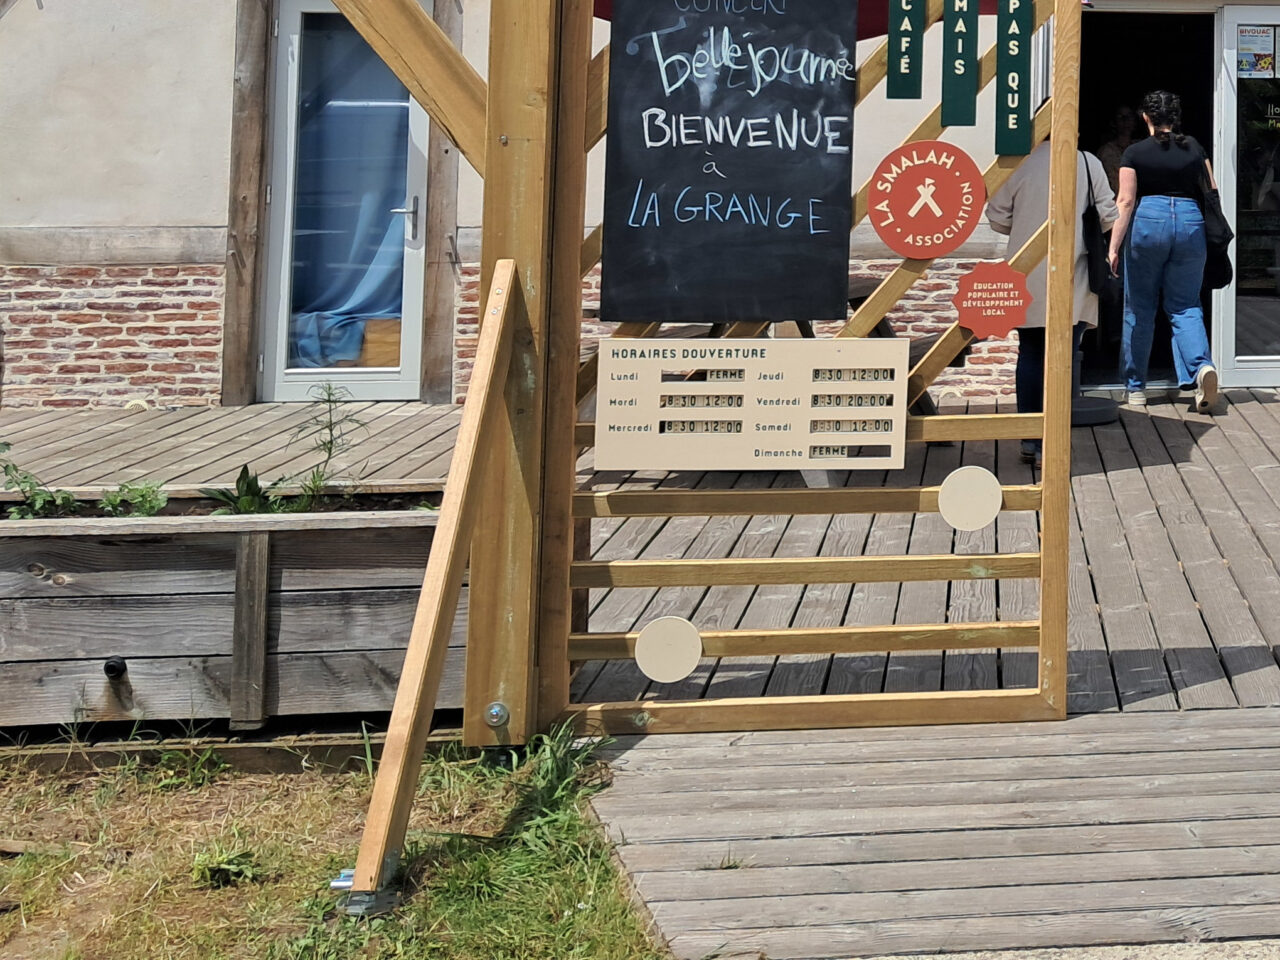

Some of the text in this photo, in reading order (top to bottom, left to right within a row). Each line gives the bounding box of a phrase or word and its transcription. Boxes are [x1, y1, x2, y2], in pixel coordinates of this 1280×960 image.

[1007, 72, 1019, 130] QUE
[642, 107, 850, 155] BIENVENUE
[702, 151, 727, 178] à
[874, 149, 955, 227] LA SMALAH
[626, 178, 831, 235] LA GRANGE
[904, 181, 974, 247] ASSOCIATION
[967, 291, 1009, 299] POPULAIRE
[962, 299, 1024, 308] DÉVELOPPEMENT
[611, 348, 767, 359] HORAIRES DOUVERTURE
[610, 372, 639, 381] Lundi
[757, 368, 889, 381] Jeudi 8:30 12:00
[609, 395, 743, 408] Mardi 8:30 12:00
[756, 395, 885, 407] Vendredi 8:30 20:00
[608, 421, 742, 433] Mercredi 8:30 12:00
[754, 420, 890, 432] Samedi 8:30 12:00
[754, 448, 803, 458] Dimanche
